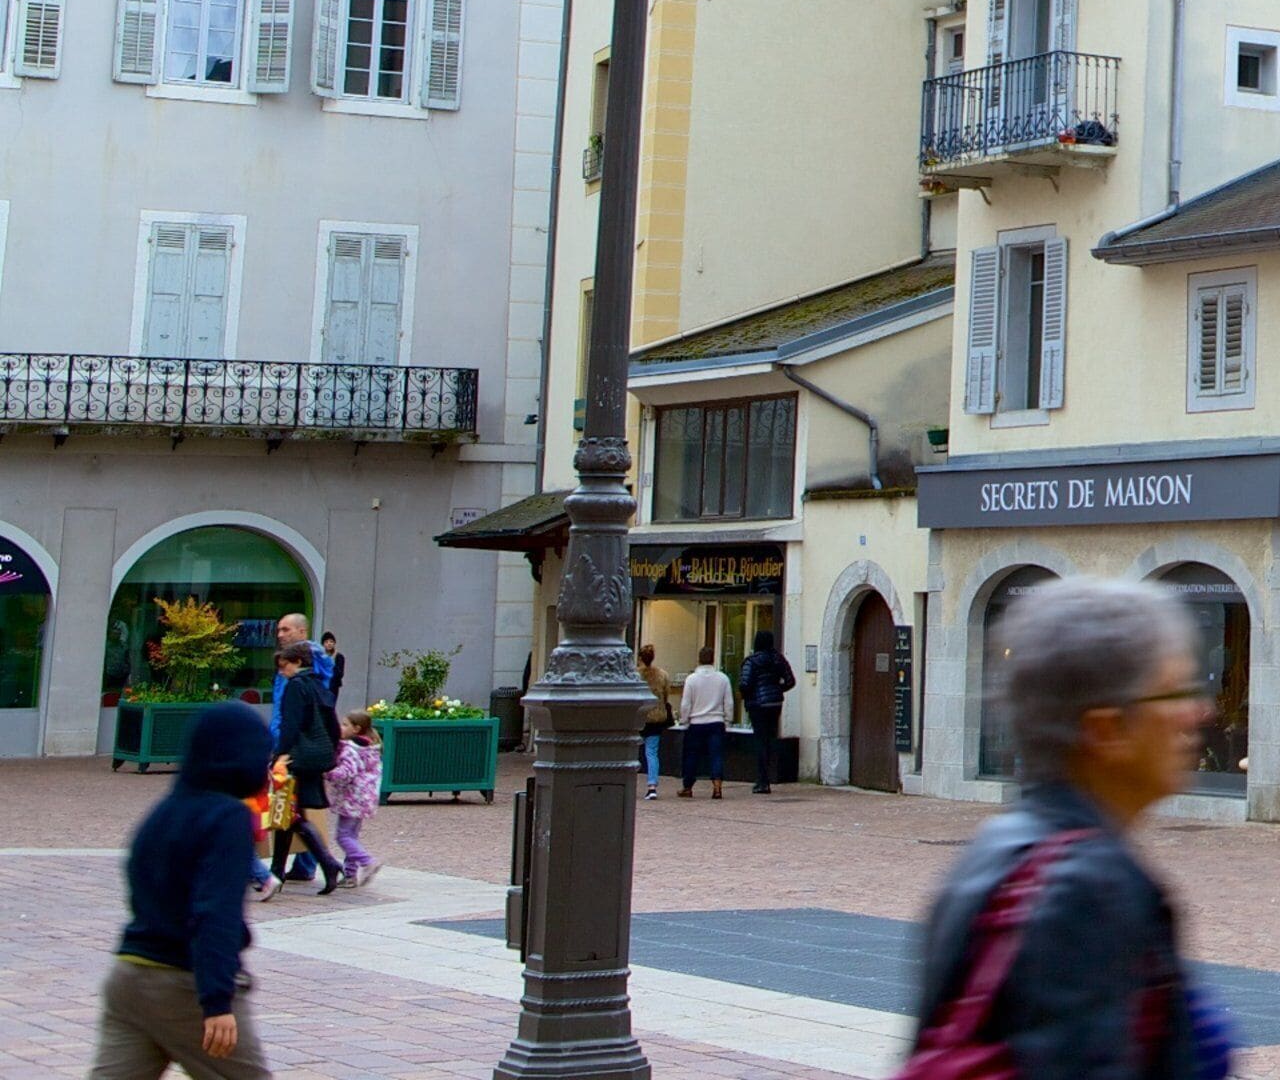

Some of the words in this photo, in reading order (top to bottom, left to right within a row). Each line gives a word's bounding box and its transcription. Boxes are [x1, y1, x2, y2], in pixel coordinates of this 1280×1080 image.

[981, 480, 1058, 511] SECRETS
[1067, 479, 1095, 509] DE
[1104, 474, 1193, 507] MAISON
